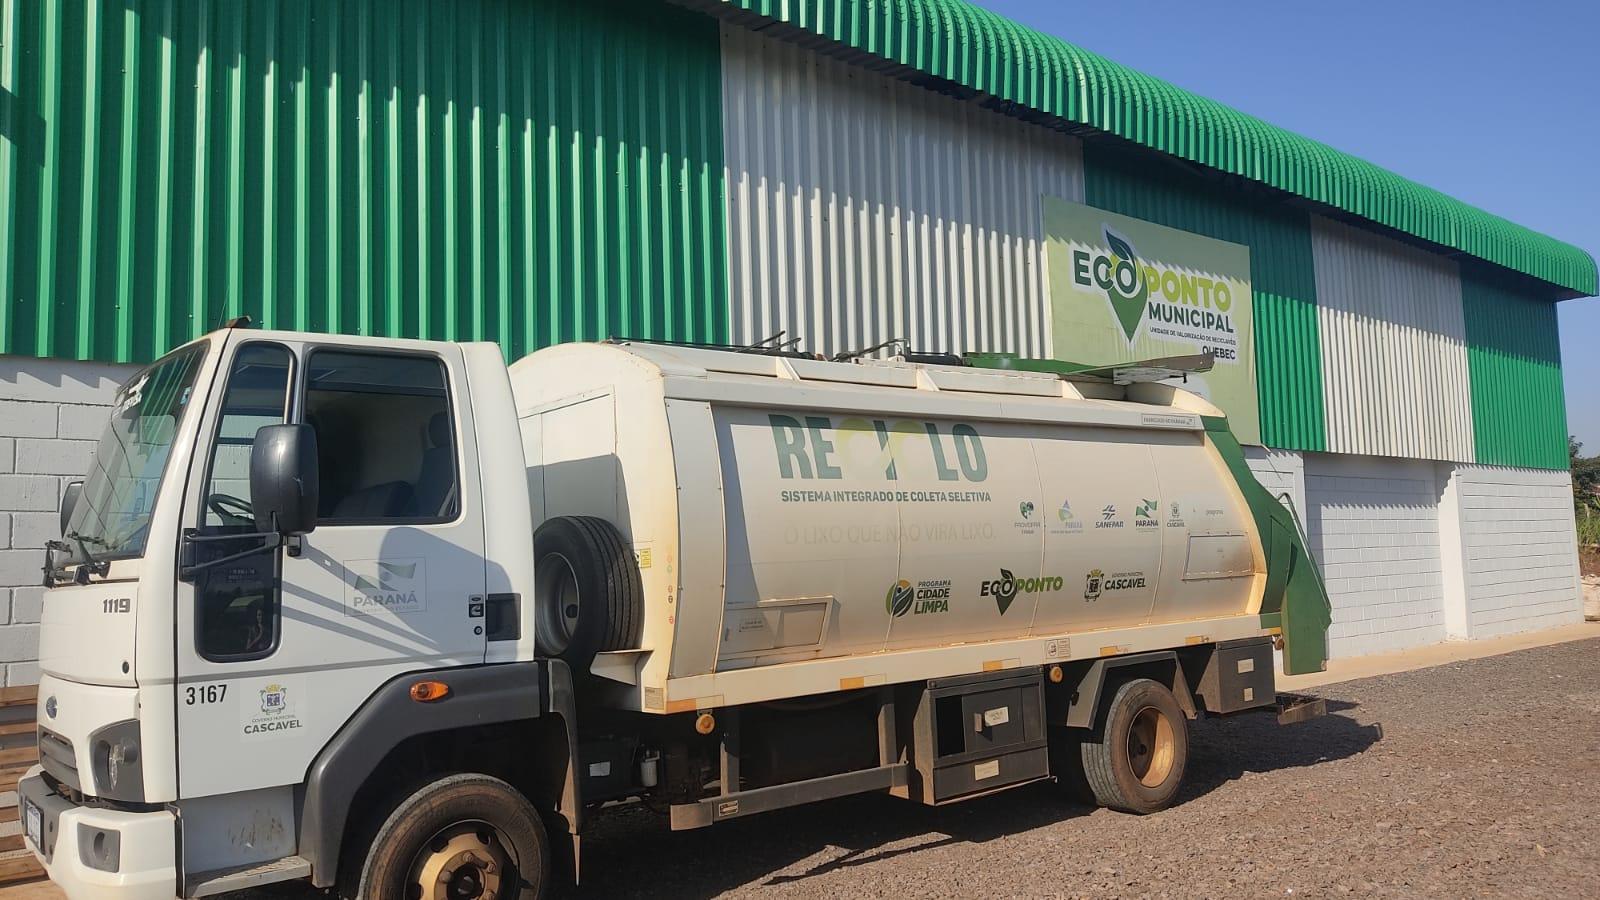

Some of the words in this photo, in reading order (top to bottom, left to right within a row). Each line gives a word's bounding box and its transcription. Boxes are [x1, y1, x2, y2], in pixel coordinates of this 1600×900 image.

[1073, 250, 1232, 313] ECOPONTO
[1148, 302, 1234, 333] MUNICIPAL
[1150, 326, 1170, 336] UNIDADE
[1177, 331, 1206, 341] VALORIZAÇÃO
[1202, 345, 1236, 360] QUEBEC
[781, 490, 832, 502] SISTEMA
[833, 491, 894, 502] INTEGRADO
[895, 491, 909, 502] DE
[910, 491, 947, 502] COLETA
[948, 492, 992, 502] SELETIVA
[804, 525, 842, 544] LIXO
[847, 525, 881, 543] QUE
[925, 522, 958, 541] VIRA
[980, 576, 1063, 596] ECOPONTO
[1104, 578, 1146, 590] CASCAVEL
[353, 590, 417, 607] PARANÁ
[916, 588, 950, 600] CIDADE
[103, 598, 131, 613] 1119
[914, 600, 949, 615] LIMPA
[186, 684, 228, 705] 3167
[244, 719, 303, 734] CASCAVEL
